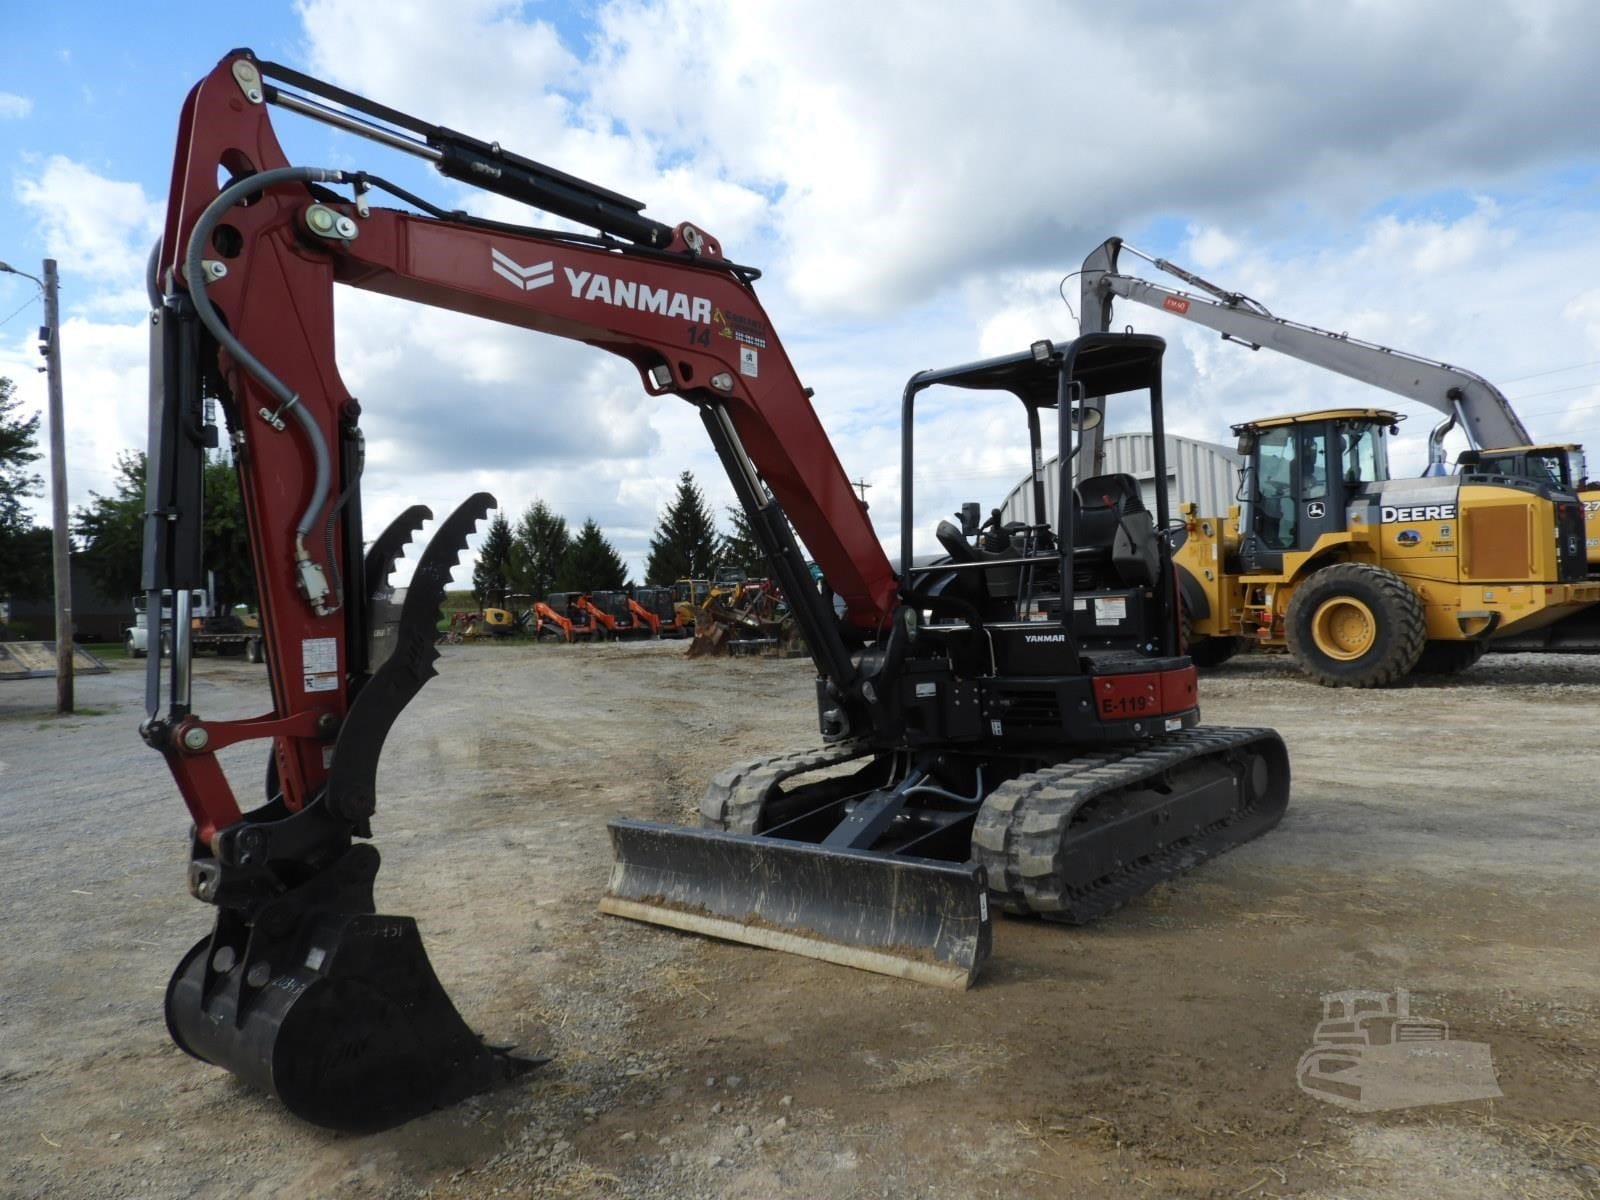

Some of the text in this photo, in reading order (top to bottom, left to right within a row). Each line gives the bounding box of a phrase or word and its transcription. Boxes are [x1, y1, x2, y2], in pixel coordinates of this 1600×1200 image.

[564, 267, 711, 324] YANMAR
[688, 325, 711, 348] 14
[1381, 504, 1455, 523] DEERE
[1024, 634, 1065, 643] YANMAR
[1102, 696, 1146, 713] E-119
